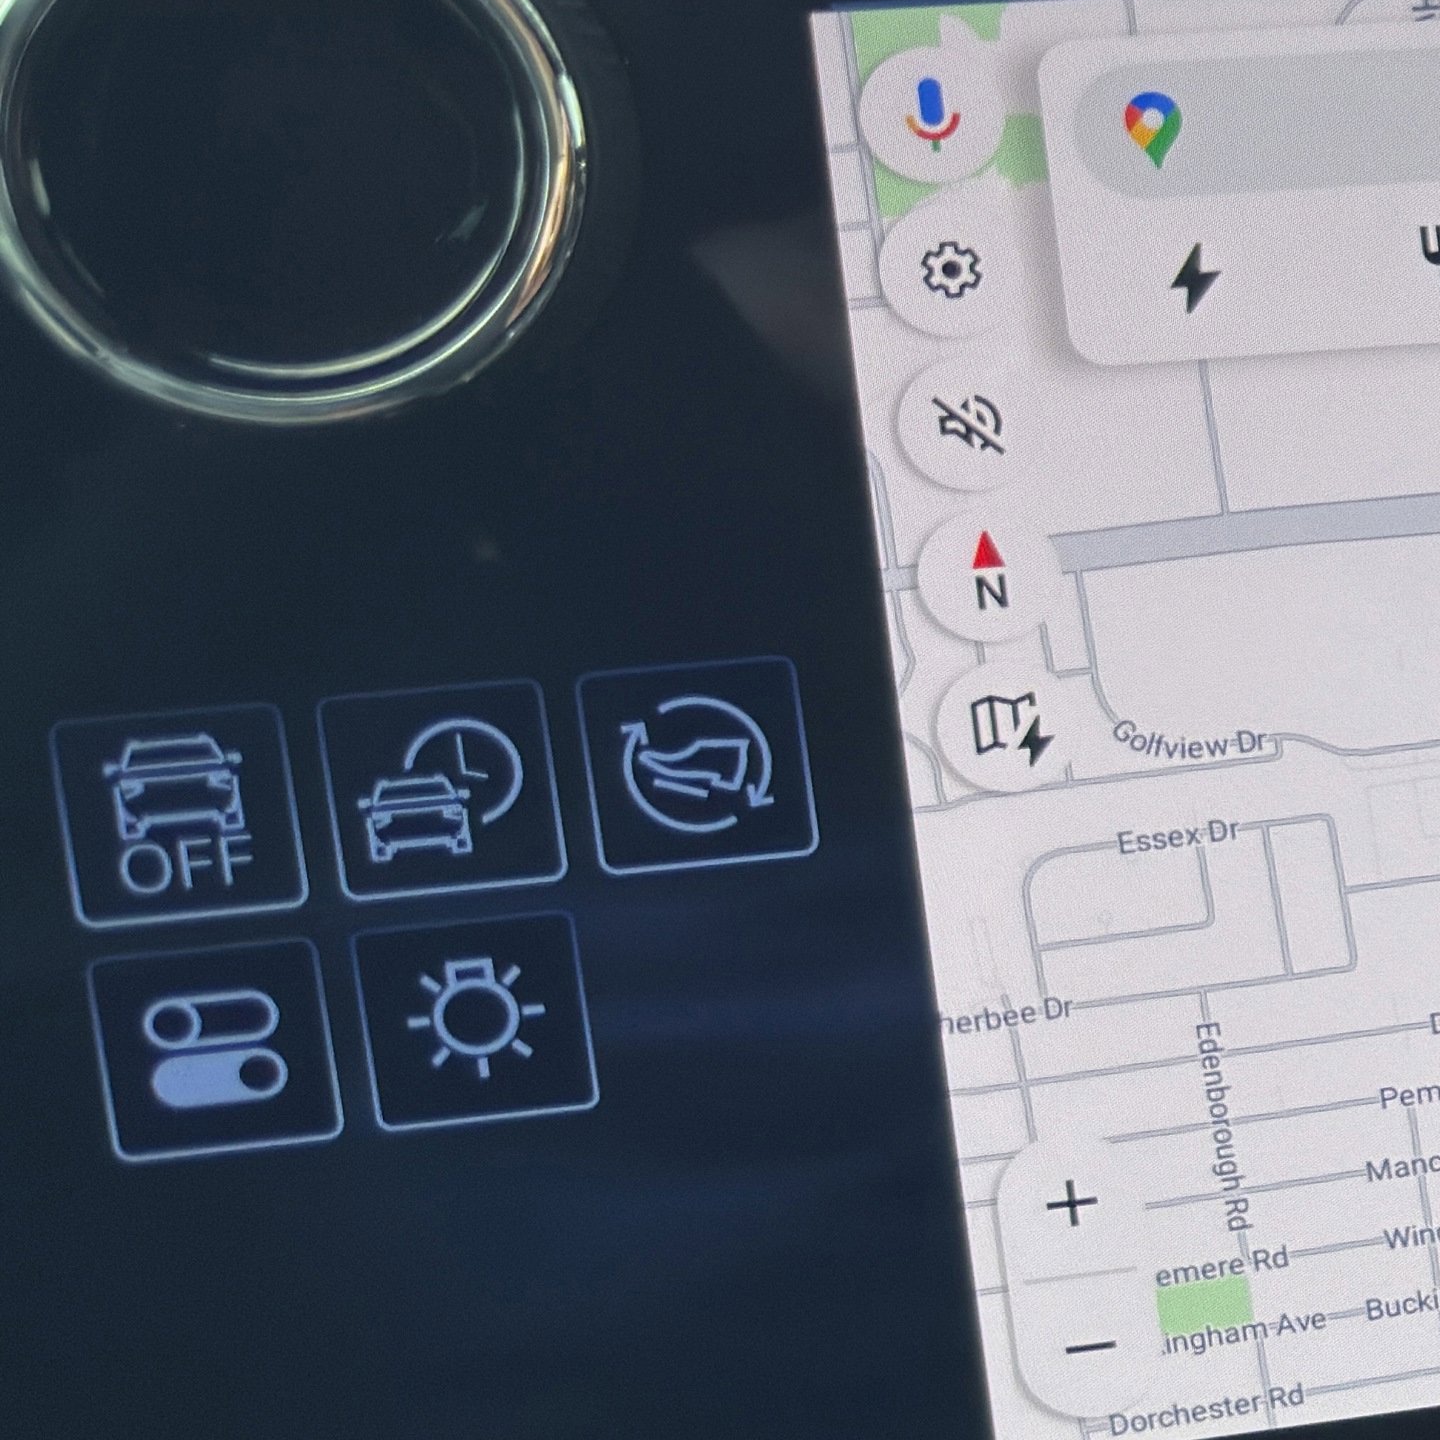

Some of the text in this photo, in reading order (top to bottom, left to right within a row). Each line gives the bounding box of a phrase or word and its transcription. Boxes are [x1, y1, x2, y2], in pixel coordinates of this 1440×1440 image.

[975, 576, 1008, 609] N
[1112, 719, 1267, 759] Golfview Dr
[1117, 819, 1240, 855] Essex Dr
[120, 833, 254, 894] OFF
[1196, 1021, 1253, 1233] Edenborough Rd
[1109, 1385, 1305, 1436] Dorchester Rd
